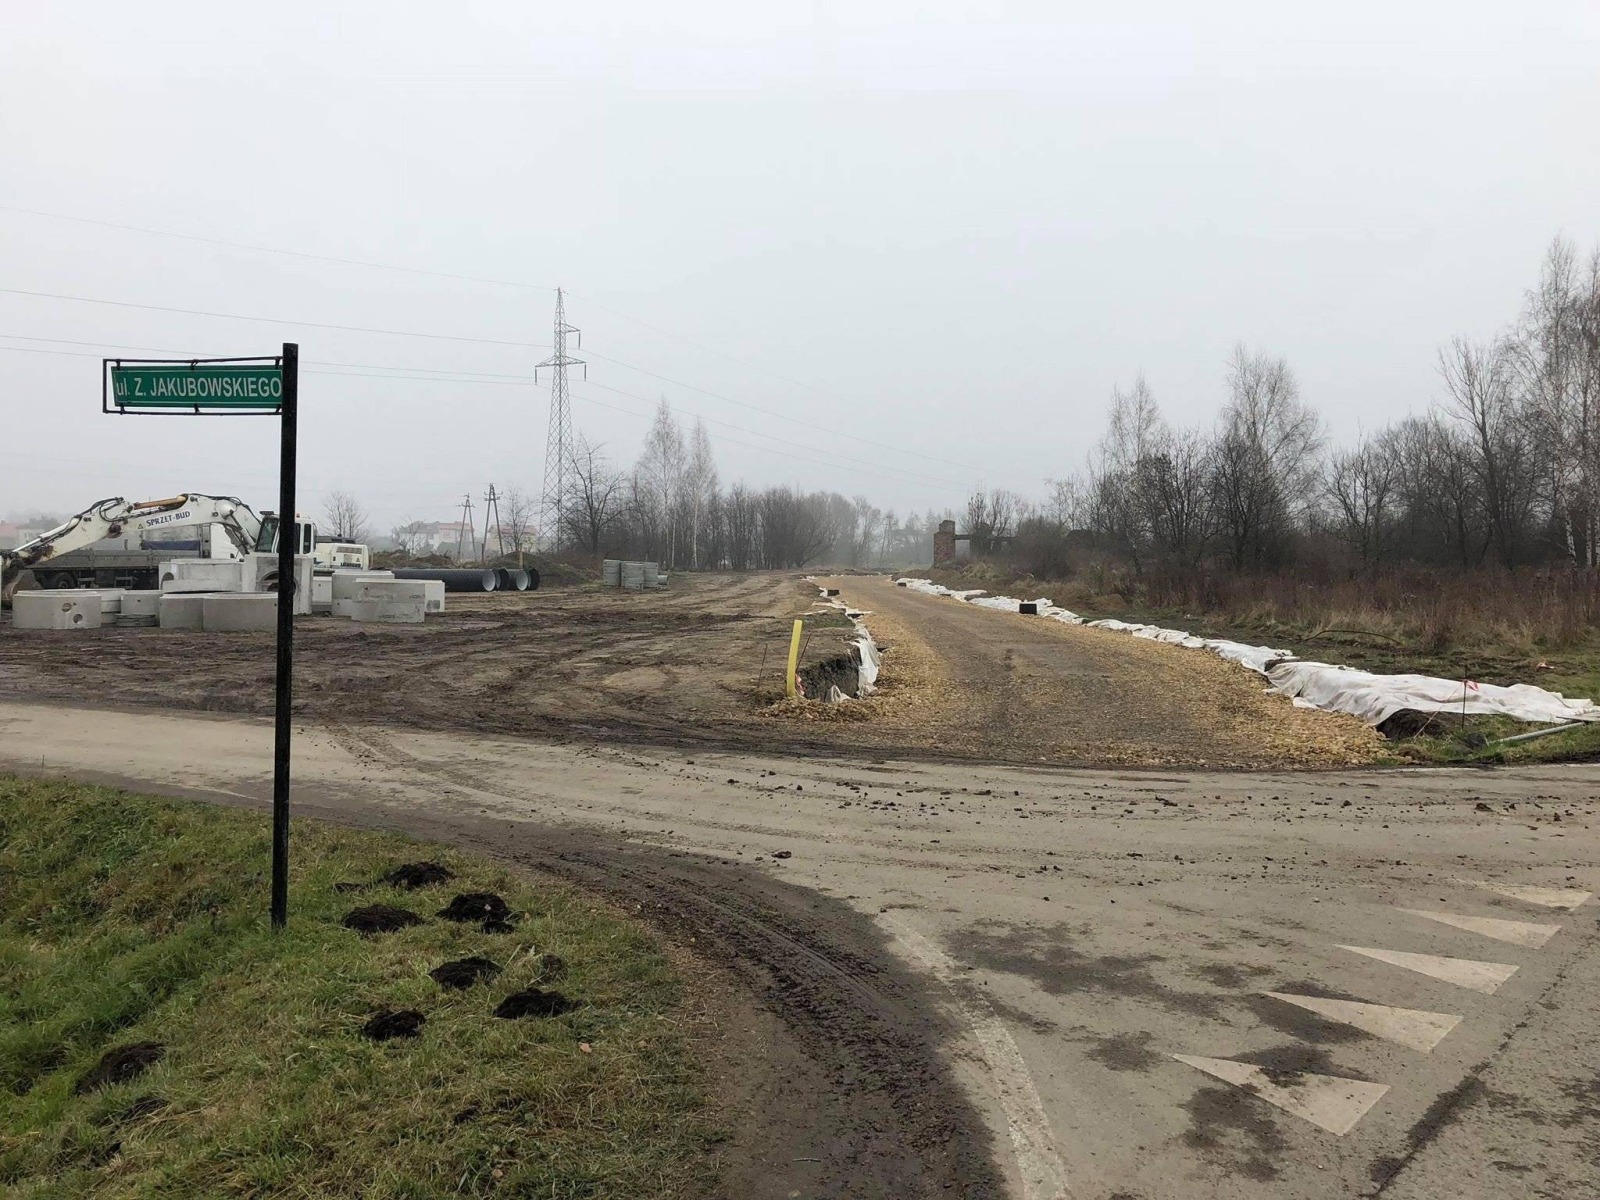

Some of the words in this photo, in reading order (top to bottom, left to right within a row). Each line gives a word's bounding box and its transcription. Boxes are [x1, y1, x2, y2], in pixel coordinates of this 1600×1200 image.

[116, 378, 131, 396] ul.
[134, 378, 147, 396] Z.
[150, 377, 282, 397] JAKUBOWSKIEGO
